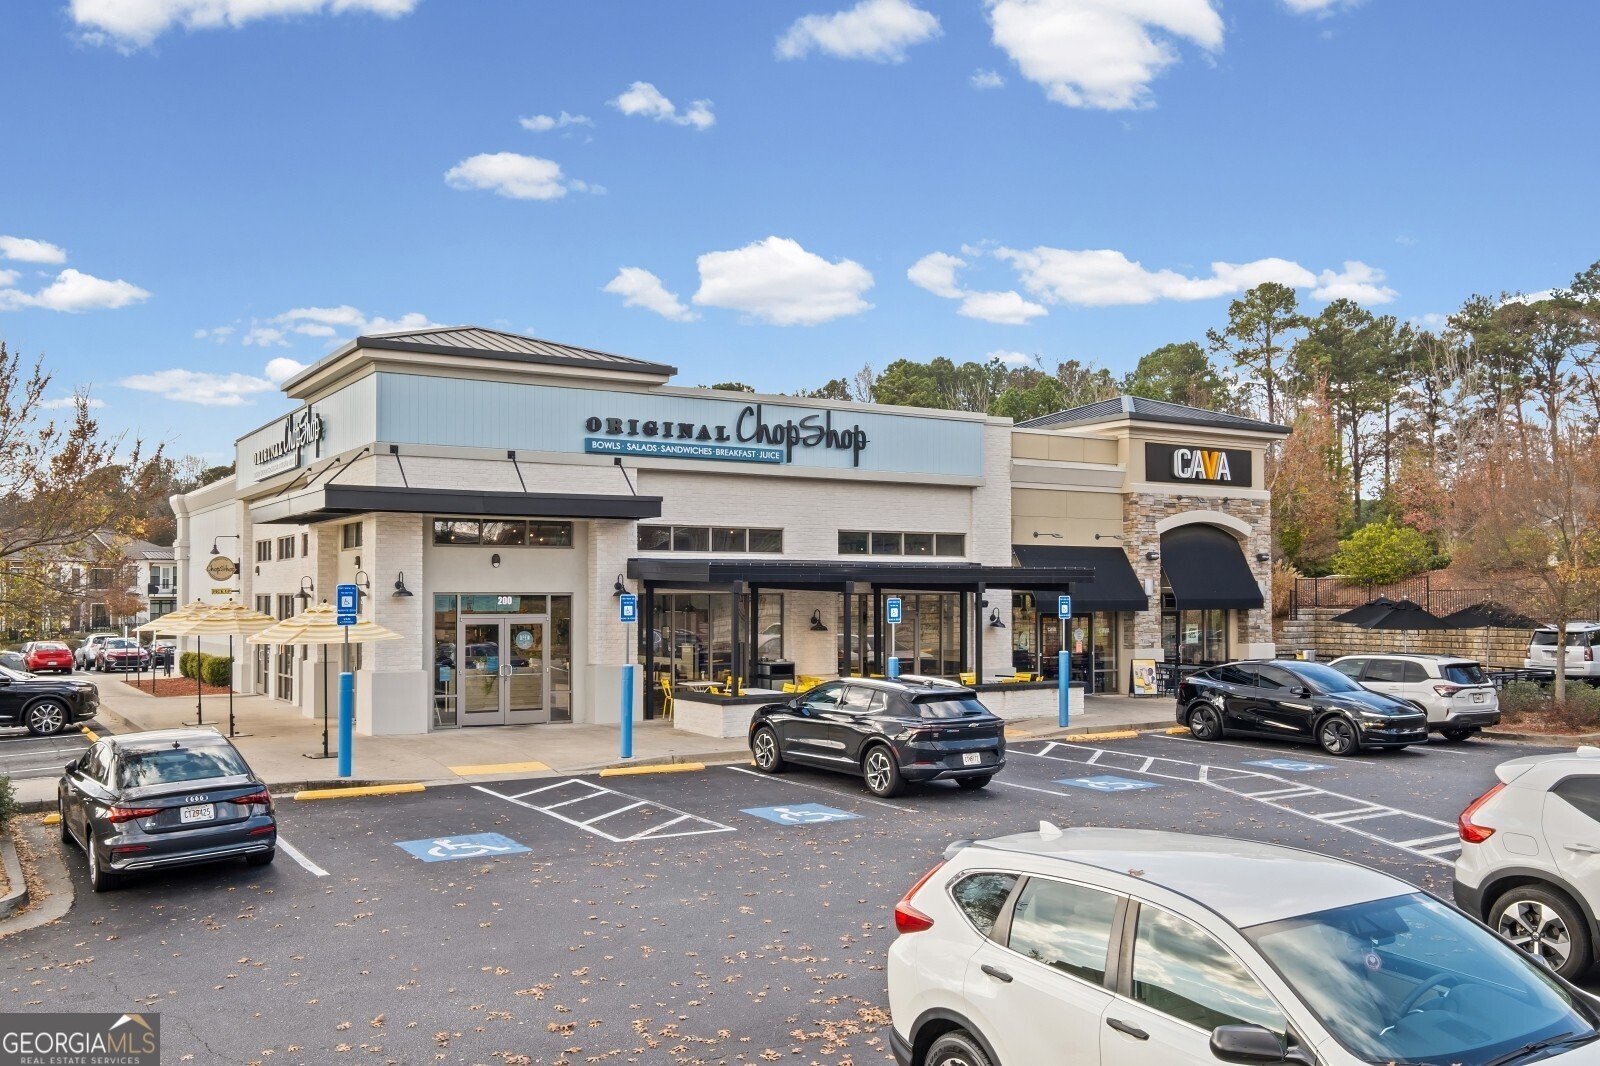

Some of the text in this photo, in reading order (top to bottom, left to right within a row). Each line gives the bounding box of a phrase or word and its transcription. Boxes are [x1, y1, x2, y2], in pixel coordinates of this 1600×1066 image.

[585, 404, 871, 467] ORIGINAL ChopShop
[591, 440, 780, 460] BOWLS SALADS SANDWICHES BREAKFAST JUICE
[1173, 448, 1232, 481] CAVA
[497, 596, 513, 605] 200
